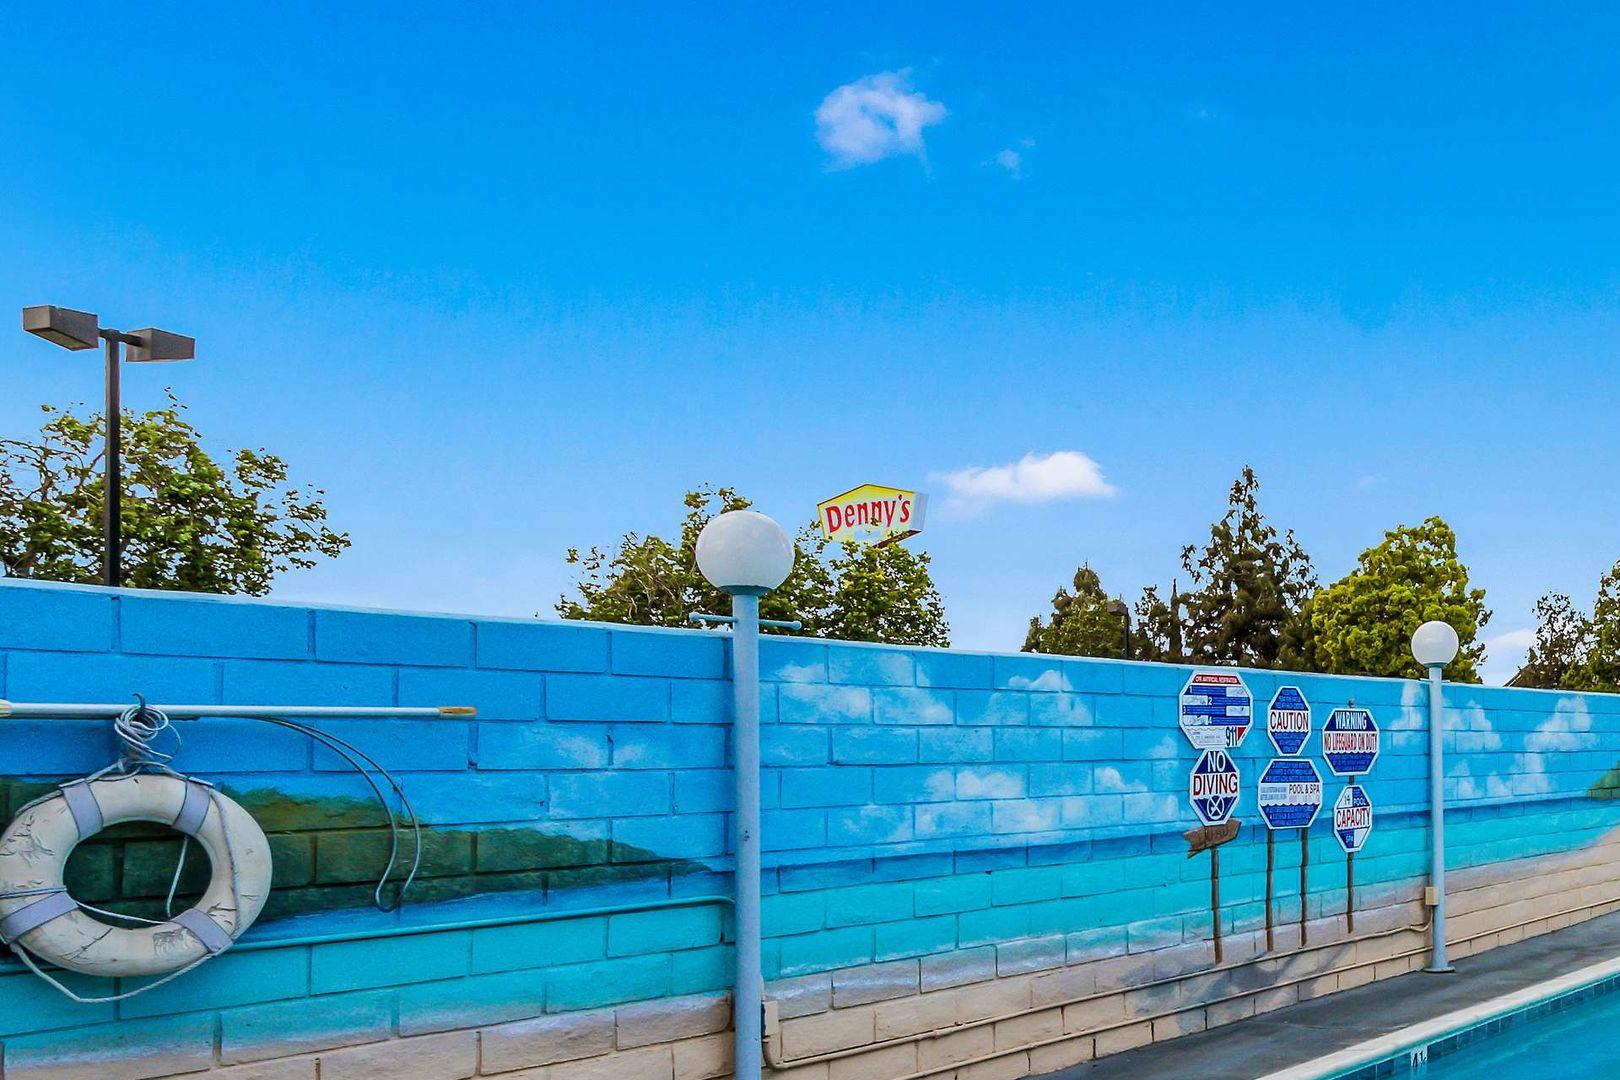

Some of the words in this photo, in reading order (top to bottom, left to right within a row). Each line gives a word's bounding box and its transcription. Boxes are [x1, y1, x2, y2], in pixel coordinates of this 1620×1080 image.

[825, 494, 911, 533] Denny's
[1270, 711, 1309, 730] CAUTION
[1335, 711, 1367, 730] WARNING
[1225, 726, 1238, 747] 911
[1207, 751, 1226, 773] NO
[1193, 773, 1238, 796] DIVING
[1289, 784, 1304, 794] POOL
[1310, 784, 1320, 794] SPA
[1337, 808, 1370, 828] CAPACITY
